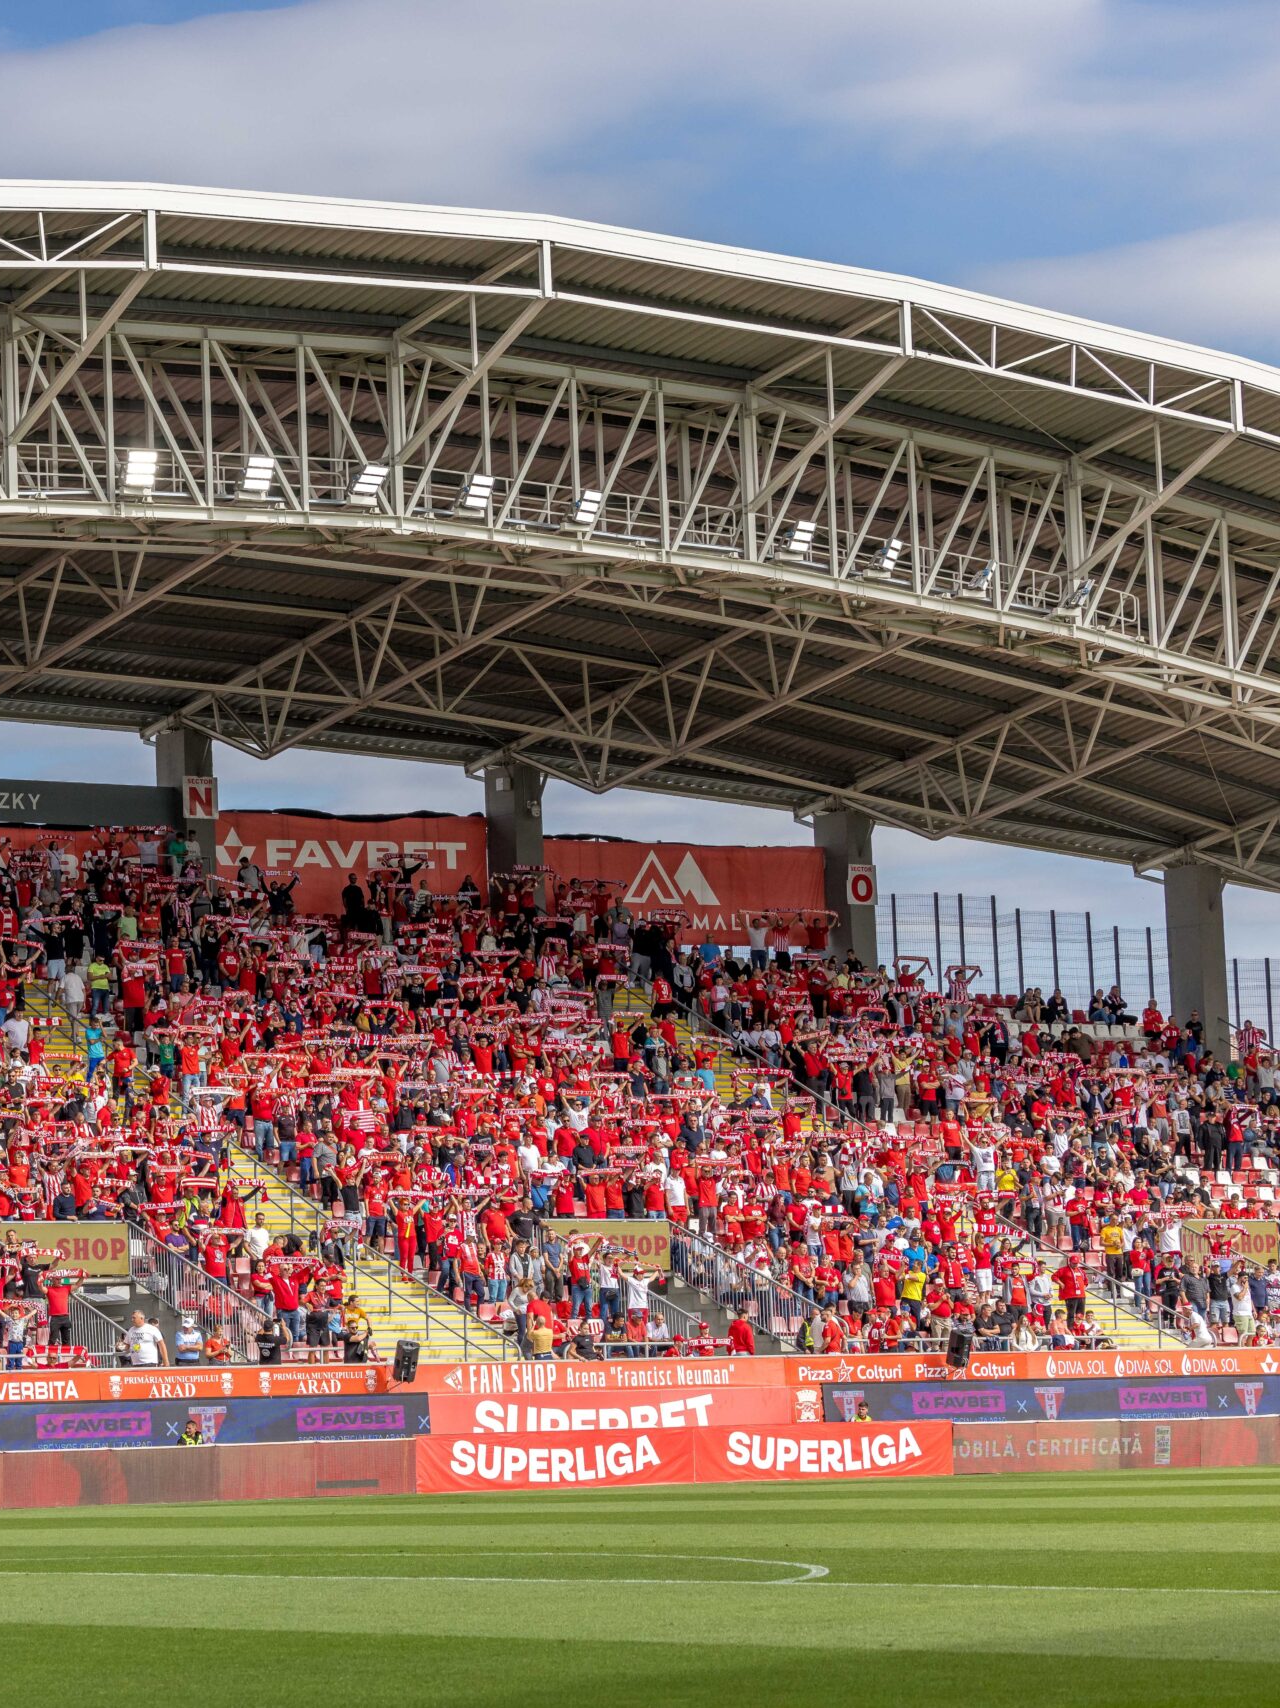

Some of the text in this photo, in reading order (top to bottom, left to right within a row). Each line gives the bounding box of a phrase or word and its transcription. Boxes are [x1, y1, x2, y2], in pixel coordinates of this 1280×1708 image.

[188, 787, 213, 817] N
[852, 874, 873, 903] O
[693, 913, 751, 931] MALL
[56, 1237, 126, 1261] SHOP
[608, 1234, 668, 1257] SHOP
[915, 1363, 949, 1378] Pizza
[1058, 1360, 1107, 1375] DIVA SOL
[1126, 1359, 1173, 1374] DIVA SOL
[1193, 1358, 1240, 1373] DIVA SOL
[124, 1373, 219, 1385] PRIMĂRIA MUNICIPIULUI
[273, 1370, 363, 1381] PRIMĂRIA MUNICIPIULUI
[470, 1363, 735, 1394] FAN SHOP Arena "Francisc Neuman"
[799, 1366, 833, 1382] Pizza
[149, 1382, 196, 1399] ARAD
[296, 1379, 341, 1394] ARAD
[934, 1395, 1002, 1410] FAVBET
[1139, 1390, 1203, 1404] FAVBET
[63, 1416, 146, 1434] FAVBET
[321, 1410, 400, 1426] FAVBET
[726, 1426, 923, 1473] SUPERLIGA
[1027, 1433, 1143, 1456] CERTIFICATĂ
[450, 1434, 662, 1483] SUPERLIGA
